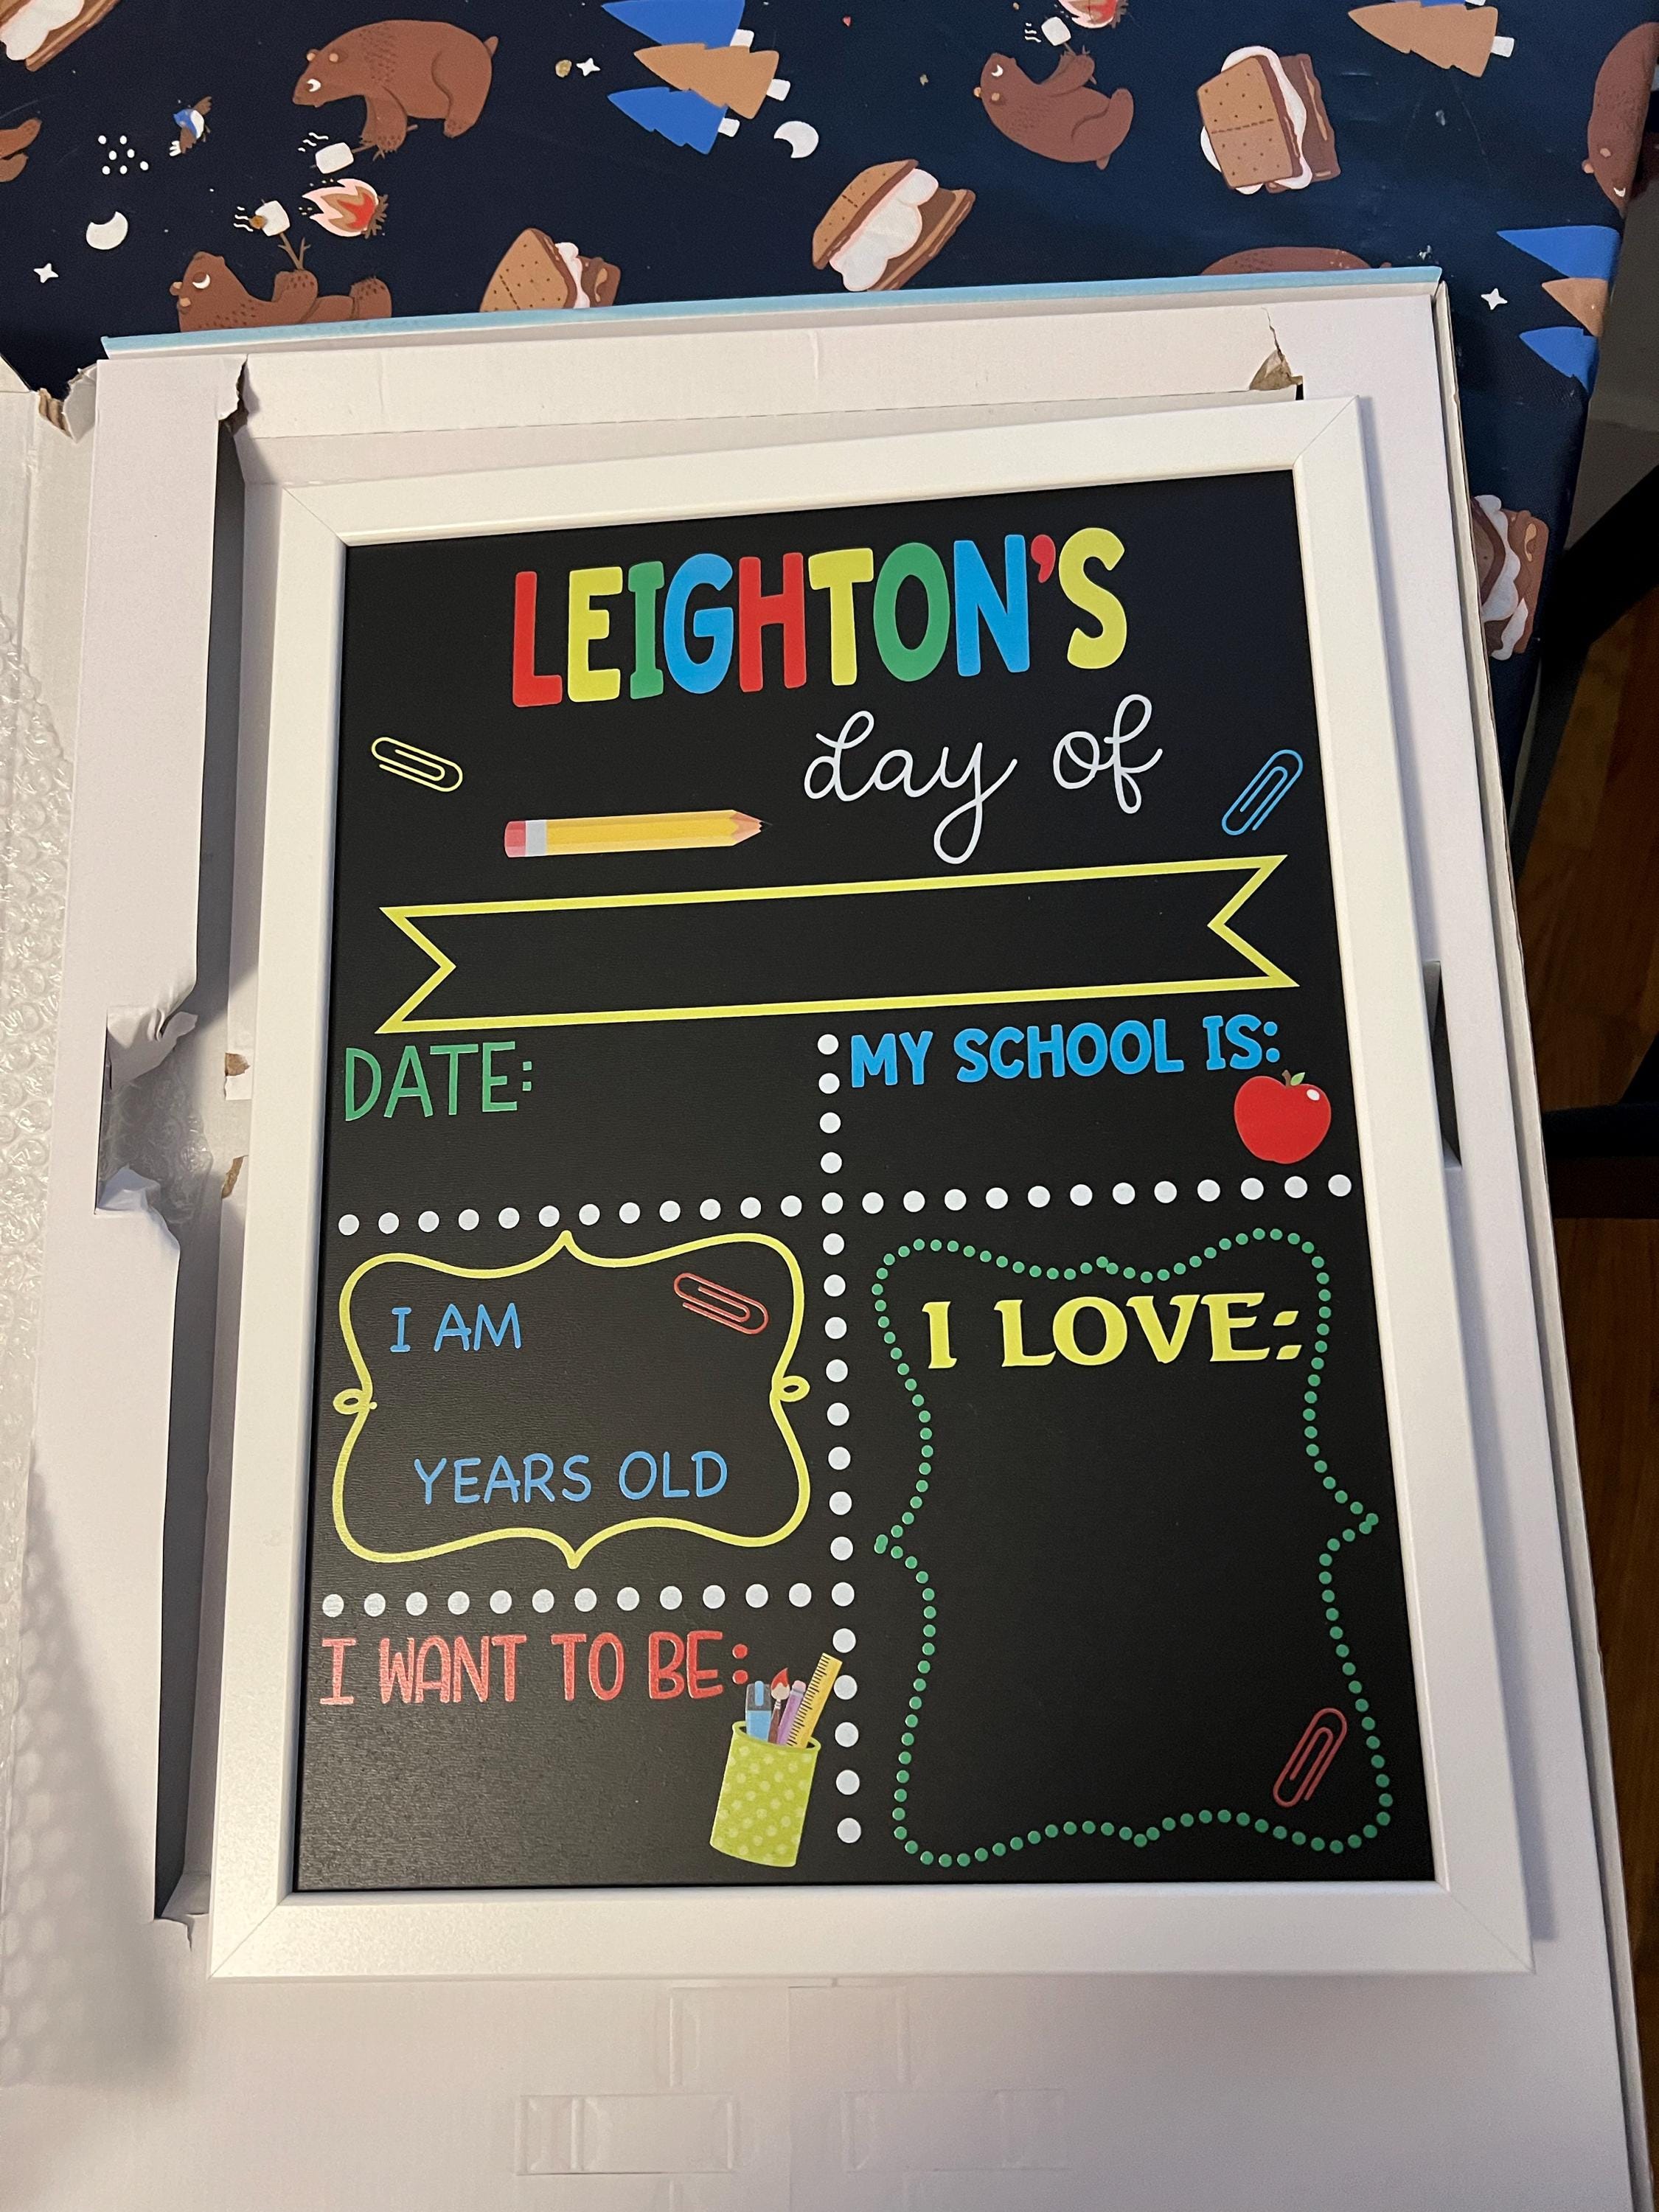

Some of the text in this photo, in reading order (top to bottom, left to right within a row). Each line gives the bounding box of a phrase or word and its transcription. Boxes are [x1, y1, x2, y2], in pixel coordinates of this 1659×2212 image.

[512, 526, 1127, 708] LEIGHTON'S
[803, 693, 1164, 865] day of
[345, 1040, 532, 1121] DATE:
[851, 1014, 1280, 1088] MY SCHOOL IS:
[389, 1302, 521, 1352] I AM
[922, 1291, 1302, 1369] I LOVE:
[414, 1450, 728, 1504] YEARS OLD
[320, 1630, 748, 1705] I WANT TO BE:
